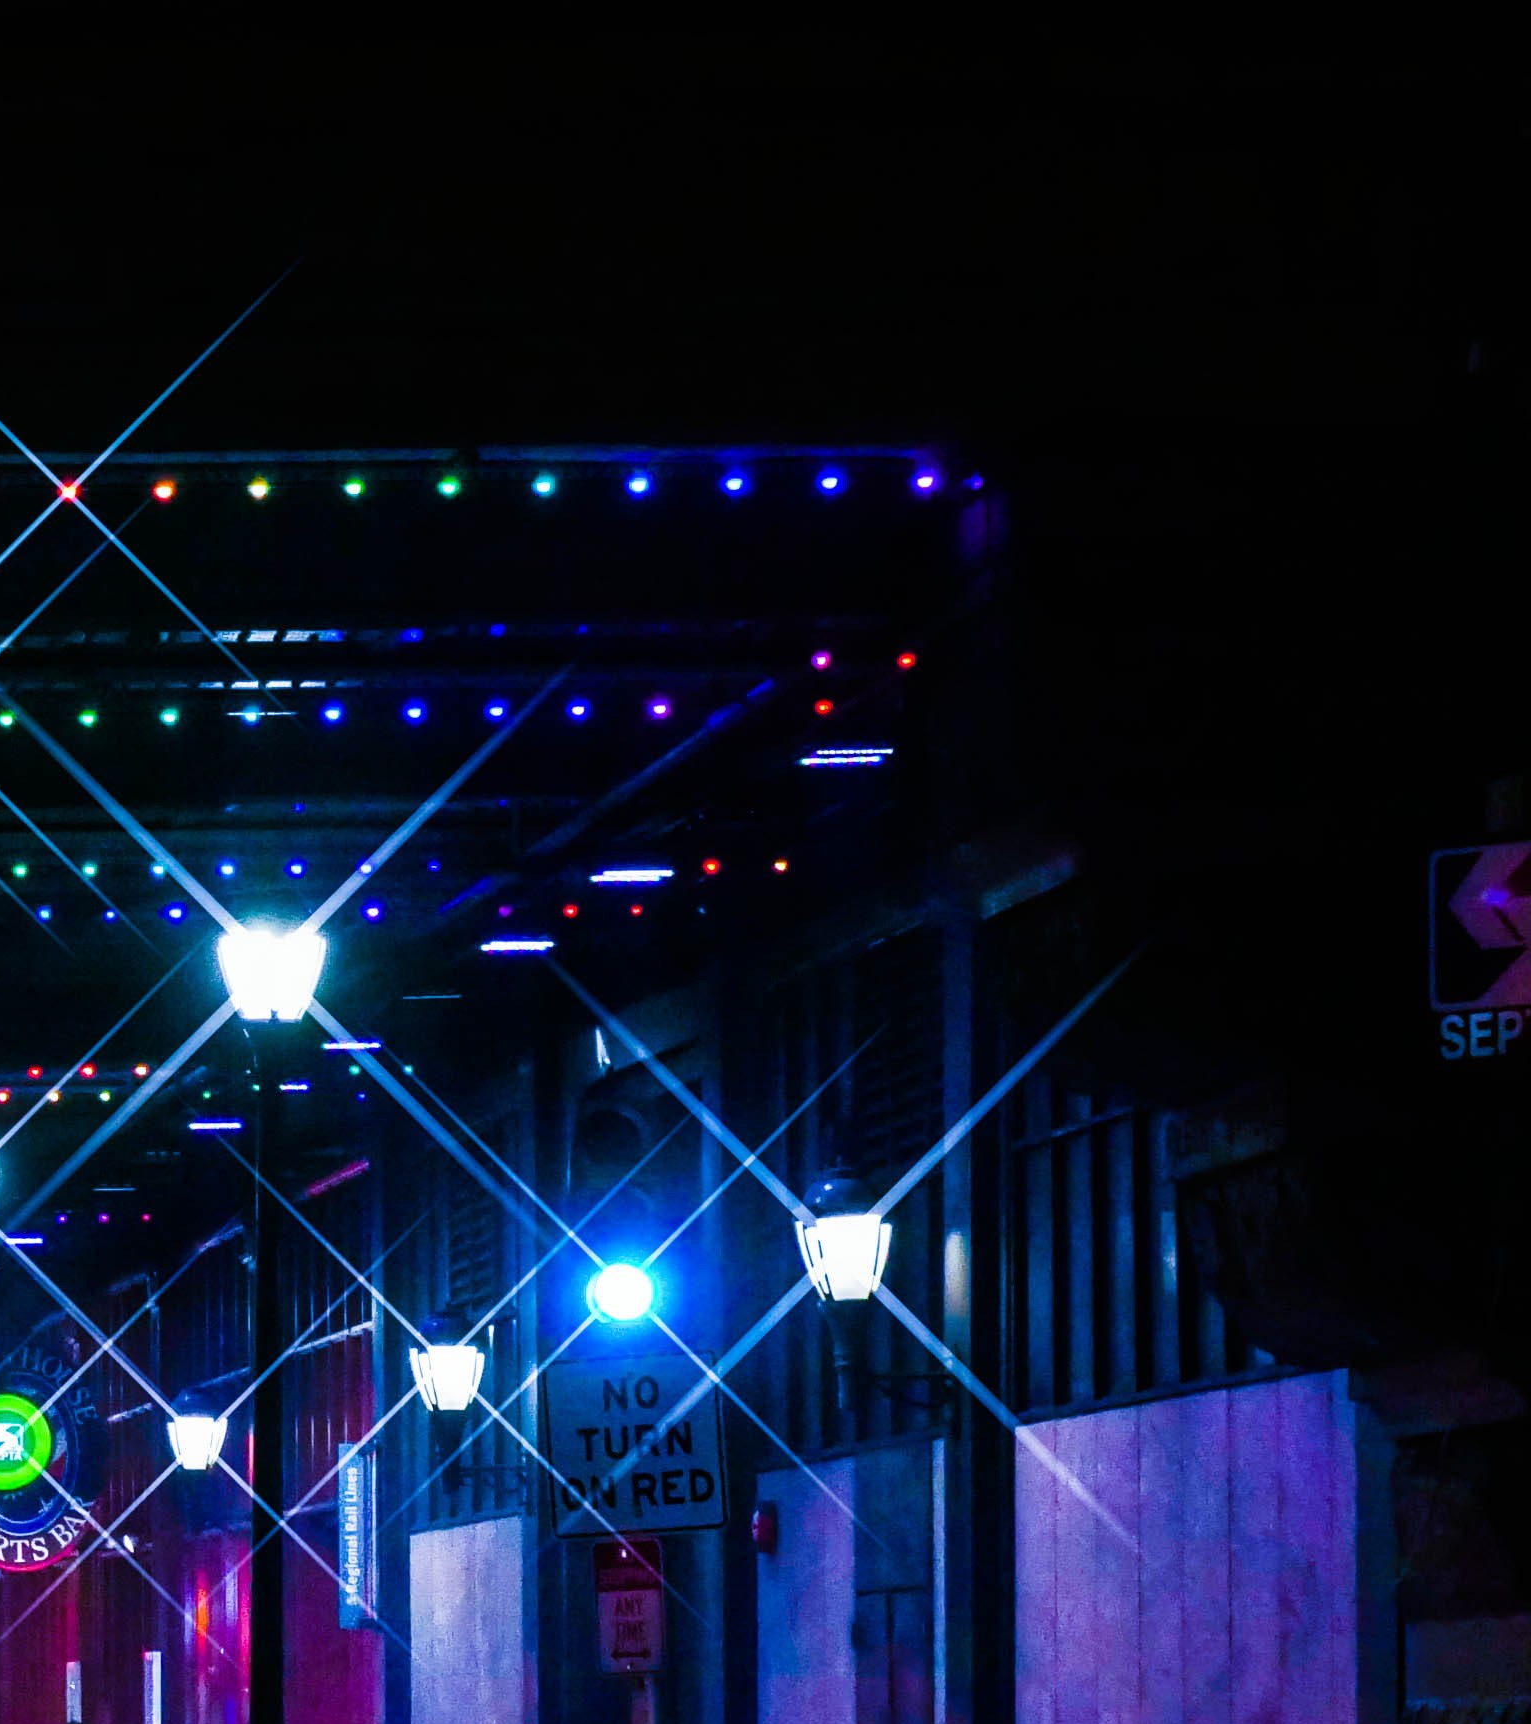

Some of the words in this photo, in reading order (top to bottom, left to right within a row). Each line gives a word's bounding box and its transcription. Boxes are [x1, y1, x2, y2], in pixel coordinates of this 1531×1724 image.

[1441, 1010, 1531, 1060] SEP
[602, 1375, 659, 1412] NO
[576, 1421, 692, 1462] TURN
[345, 1467, 358, 1502] Lines
[561, 1475, 617, 1511] ON
[631, 1468, 715, 1507] RED
[345, 1506, 358, 1532] Rail
[345, 1535, 360, 1592] Regional
